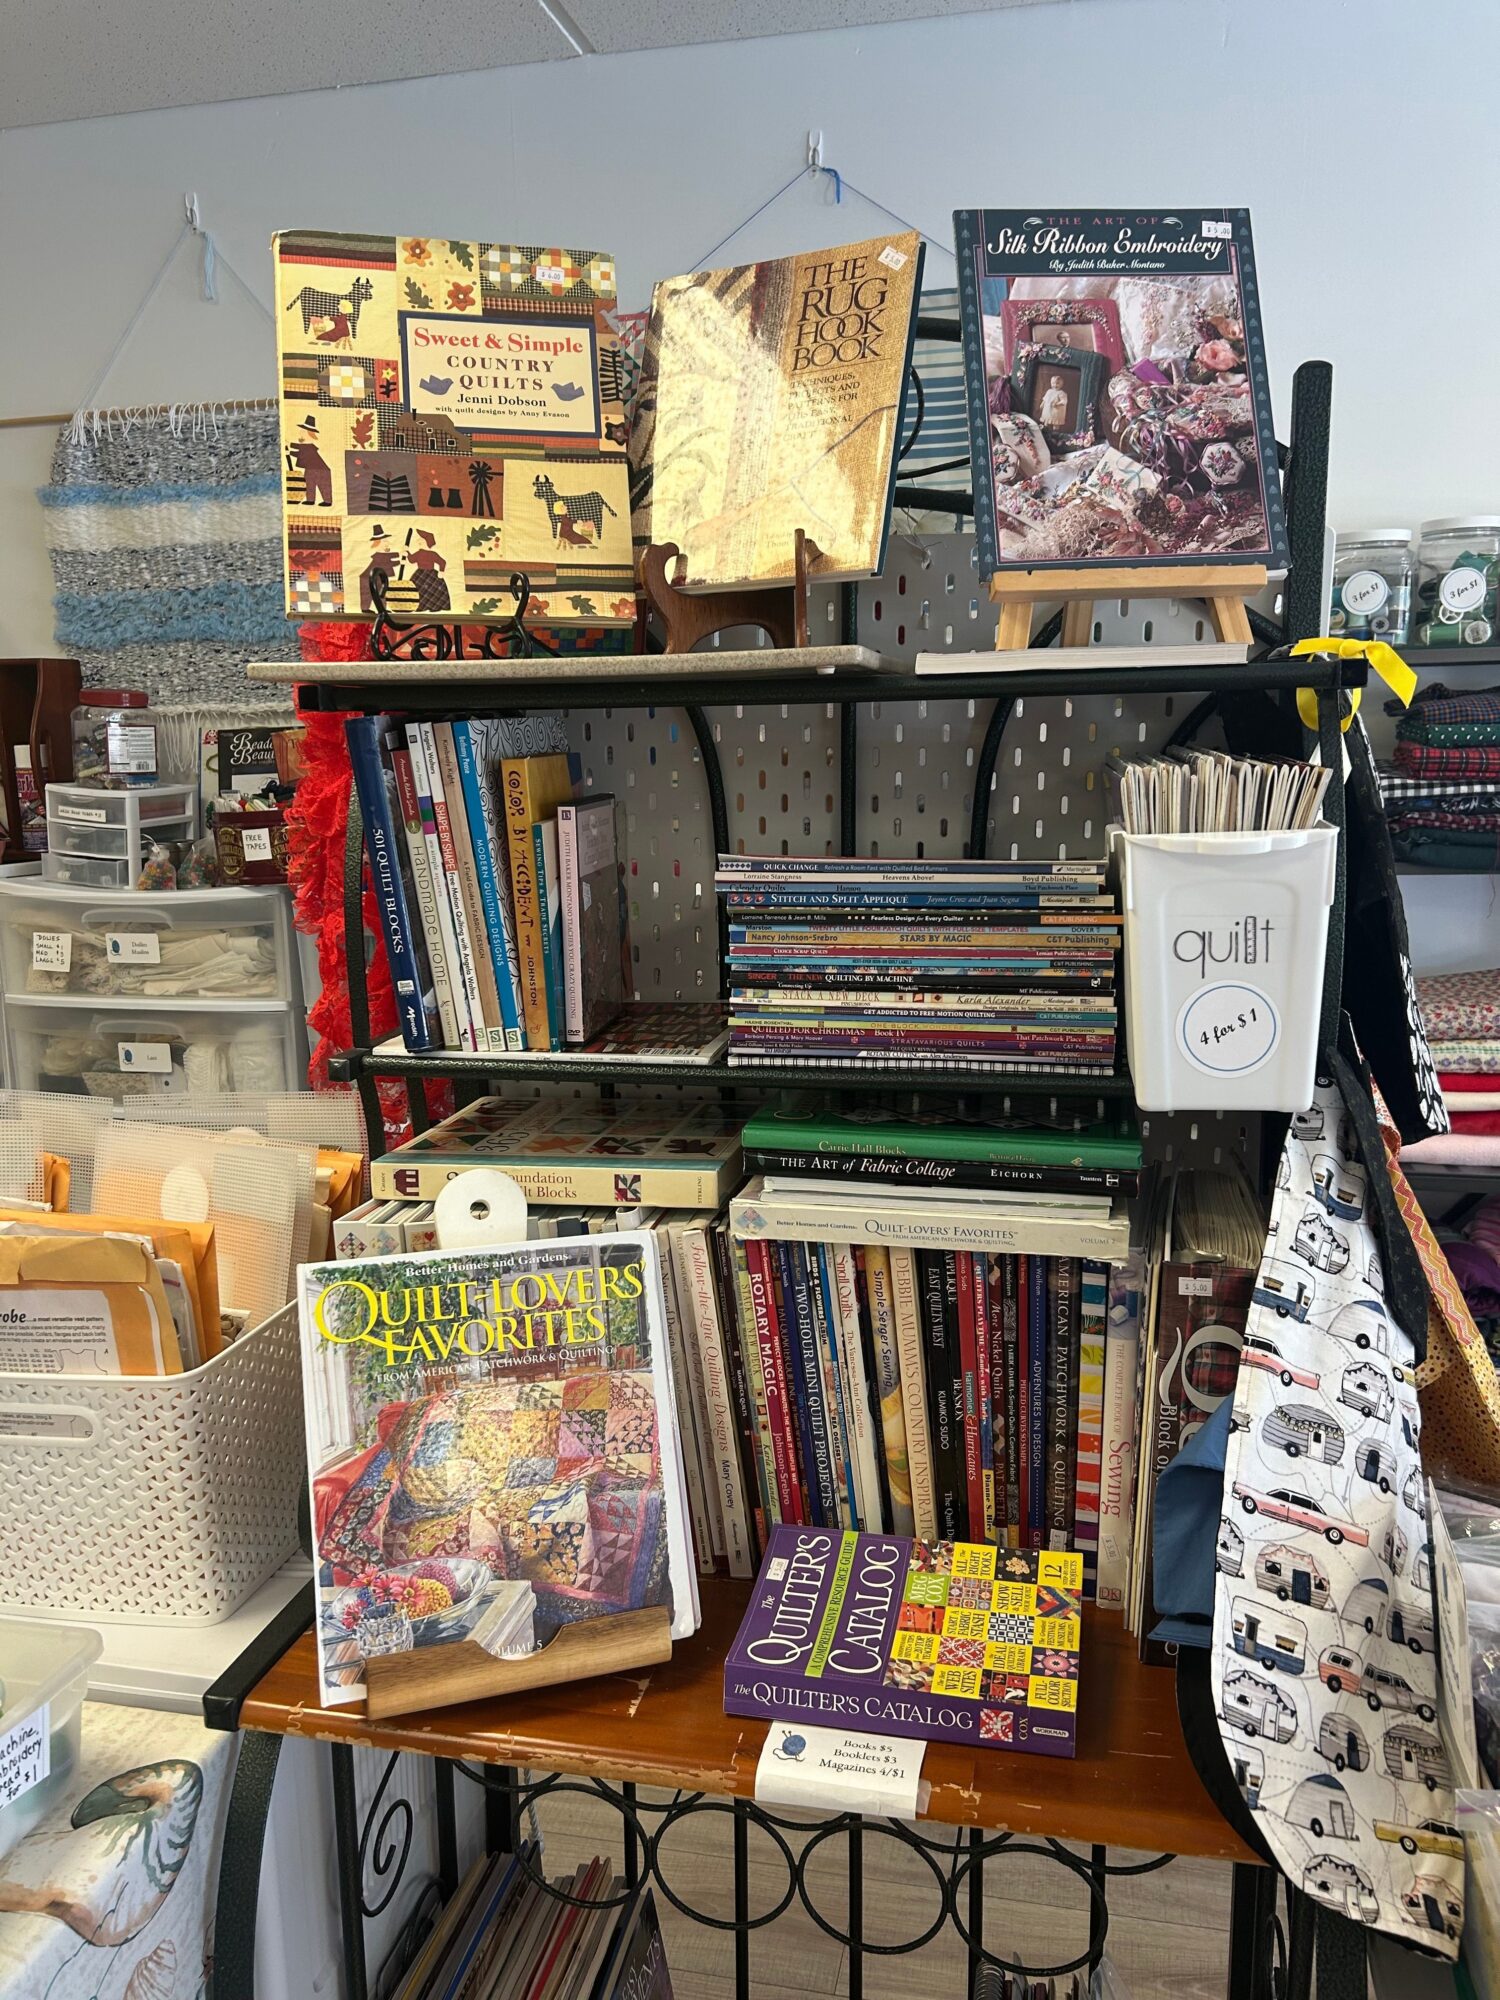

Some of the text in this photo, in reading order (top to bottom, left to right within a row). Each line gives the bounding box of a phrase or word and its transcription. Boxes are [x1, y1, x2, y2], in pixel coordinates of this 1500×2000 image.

[1047, 217, 1159, 225] THE ART OF
[988, 227, 1225, 260] Silk Ribbon Embroidery
[804, 256, 868, 288] THE
[1049, 260, 1165, 271] By Judith Baker Montano
[797, 278, 888, 322] RUG
[414, 327, 584, 355] Sweet & Simple
[795, 309, 884, 347] HOOK
[447, 355, 555, 373] COUNTRY
[792, 334, 883, 372] BOOK
[459, 374, 544, 391] QUILTS
[455, 406, 473, 416] quilt
[477, 408, 505, 418] designs
[508, 409, 517, 417] by
[543, 410, 570, 419] Evason
[457, 393, 546, 407] Jenni Dobson
[1352, 595, 1358, 603] 3
[1358, 588, 1370, 600] for
[1449, 591, 1456, 599] 3
[1457, 586, 1469, 596] for
[424, 730, 433, 751] Angela
[435, 804, 448, 831] SHAPE
[440, 830, 450, 842] BY
[442, 841, 456, 870] SHAPE
[373, 828, 403, 953] 501 QUILT BLOCKS
[477, 840, 504, 966] MODERN QUILTING DESIGNS
[771, 894, 806, 903] STITCH
[832, 894, 859, 903] SPLIT
[456, 911, 465, 937] Quilting
[778, 934, 838, 942] Johnson-Srebro
[942, 935, 972, 943] MAGIC
[1064, 936, 1109, 945] Publishing
[1172, 916, 1274, 978] quilt
[462, 953, 472, 975] Angela
[466, 975, 475, 1000] Walters
[527, 955, 538, 1006] JOHNSTON
[825, 974, 863, 982] QUILTING
[876, 975, 913, 983] MACHINE
[1200, 1031, 1209, 1045] 4
[1212, 1021, 1236, 1043] for
[780, 1156, 1043, 1180] THE ART of Fabric Collage EICHORN
[537, 1186, 577, 1199] Blocks
[405, 1264, 442, 1278] Better
[447, 1258, 490, 1274] Homes
[493, 1256, 515, 1268] and
[873, 1269, 885, 1307] Simple
[382, 1306, 606, 1367] FAVORITES
[751, 1273, 777, 1397] ROTARY MAGIC
[877, 1308, 889, 1342] Serger
[376, 1345, 613, 1384] FROM AMERICAN PATCHWORK & QUILTING
[795, 1282, 833, 1507] TWO-HOUR MINI QUILT PROJECTS
[1053, 1256, 1070, 1527] AMERICAN PATCHWORK & QUILTING
[1033, 1360, 1041, 1467] ADVENTURES IN DESIGN
[1102, 1440, 1130, 1518] Sewing
[747, 1535, 831, 1664] QUILTER'S
[910, 1575, 928, 1600] MEG
[925, 1577, 945, 1603] COX
[761, 1595, 775, 1609] The
[814, 1606, 839, 1663] COMPREHENSIVE
[830, 1564, 849, 1605] RESOURCE
[840, 1540, 854, 1564] GUIDE
[828, 1544, 899, 1673] CATALOG
[734, 1683, 973, 1729] The QUILTER'S CATALOG
[1018, 1717, 1028, 1740] COX
[833, 1749, 897, 1764] Booklets $3
[843, 1739, 893, 1753] Books $5
[819, 1758, 905, 1779] Magazines 4/$1
